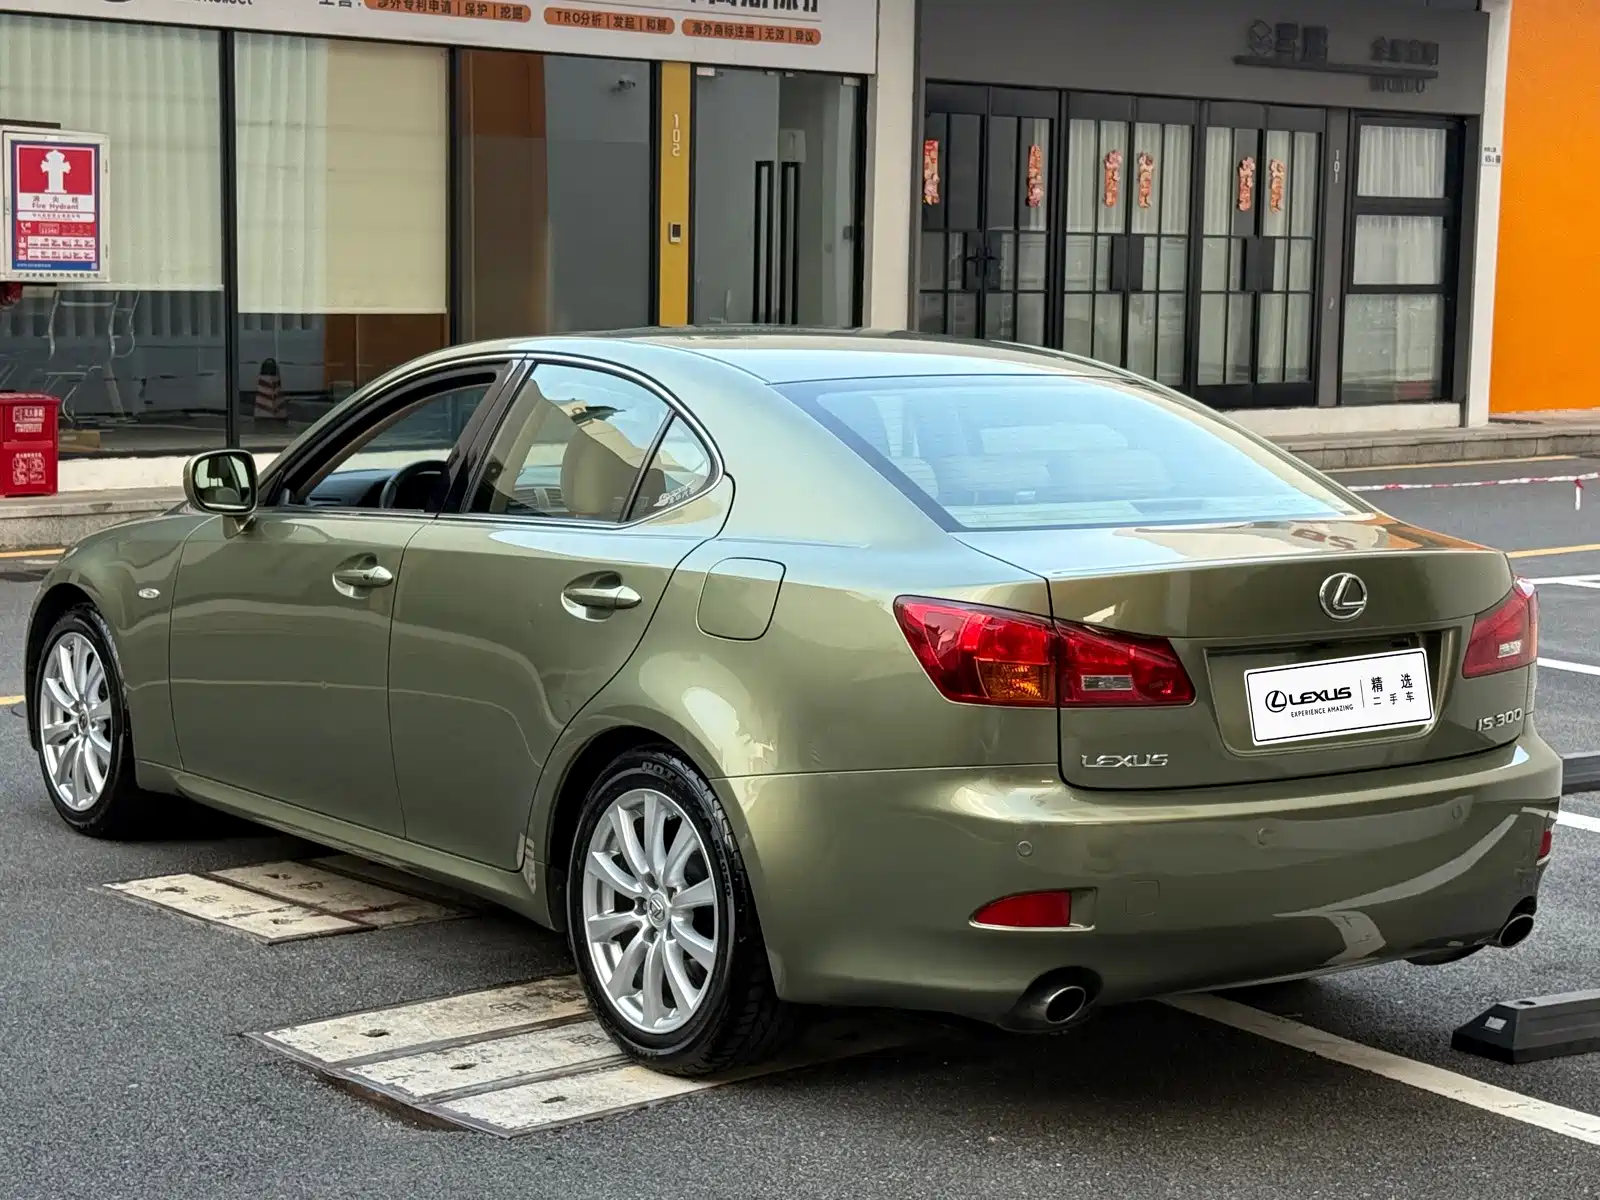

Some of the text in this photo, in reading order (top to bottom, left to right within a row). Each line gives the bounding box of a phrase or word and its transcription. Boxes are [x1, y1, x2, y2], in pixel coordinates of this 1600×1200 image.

[465, 3, 488, 16] 保护
[555, 11, 603, 27] TRO分析
[613, 16, 635, 29] 发起
[765, 28, 785, 41] 无效
[49, 203, 79, 211] Hydrant
[1371, 673, 1413, 693] 精选
[1289, 686, 1352, 706] LEXUS
[1373, 691, 1415, 706] 二手车
[1291, 703, 1354, 718] EXPERIENCE AMAZING
[1476, 707, 1523, 732] IS 300
[1081, 753, 1169, 768] LEXUS
